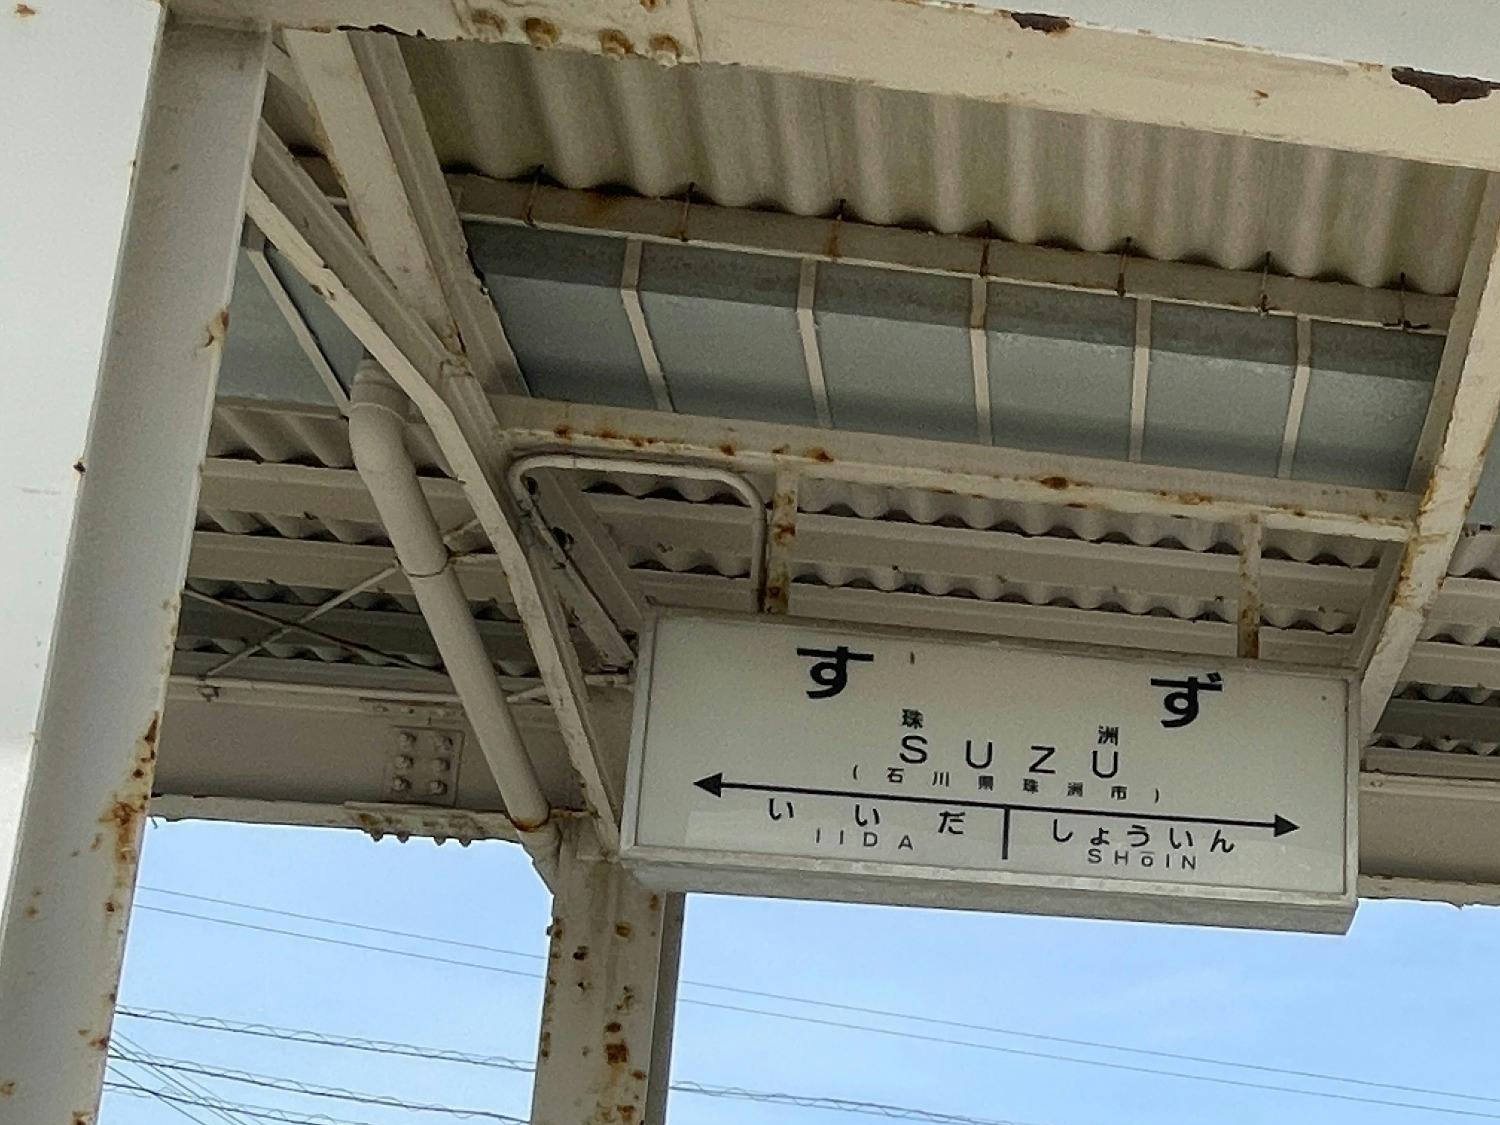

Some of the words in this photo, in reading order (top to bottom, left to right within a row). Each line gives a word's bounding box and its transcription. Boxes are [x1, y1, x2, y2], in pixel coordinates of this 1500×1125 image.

[902, 708, 1119, 746] 珠洲
[899, 735, 1119, 779] SUZU
[769, 798, 966, 835] いいだ
[815, 827, 914, 850] IIDA
[1053, 818, 1235, 853] しょういん
